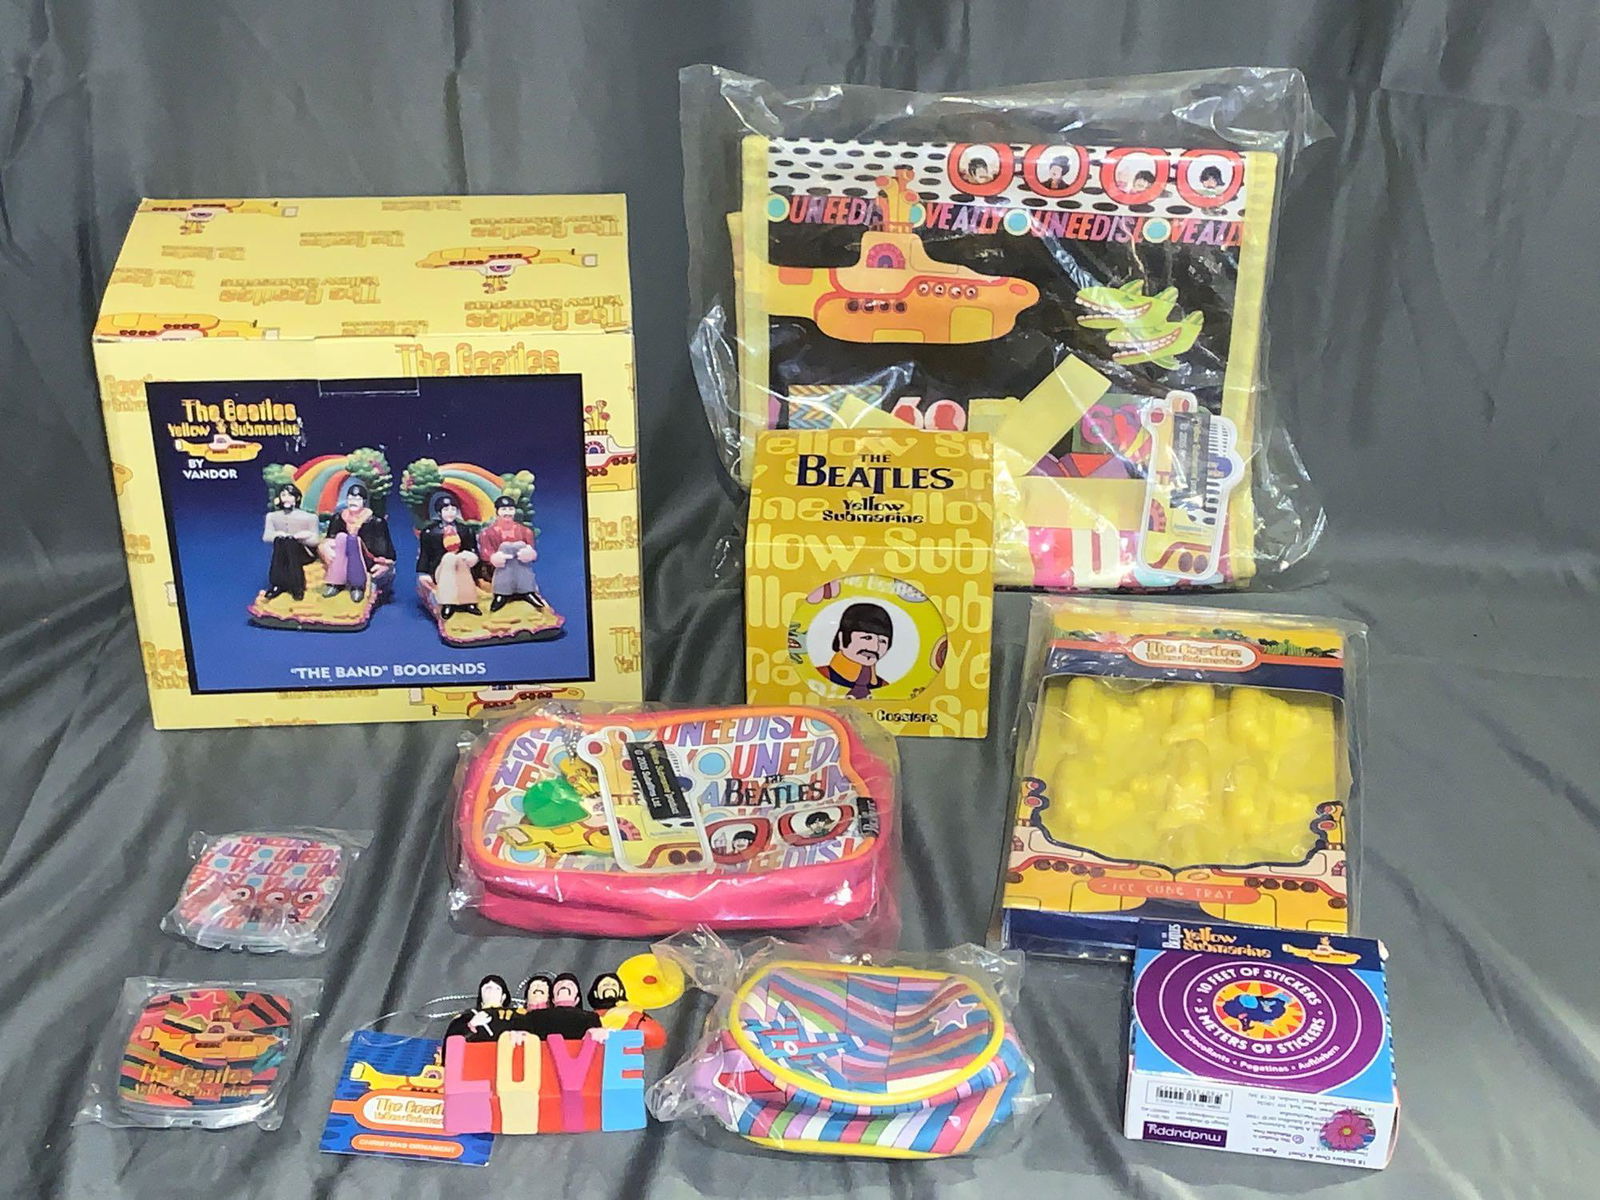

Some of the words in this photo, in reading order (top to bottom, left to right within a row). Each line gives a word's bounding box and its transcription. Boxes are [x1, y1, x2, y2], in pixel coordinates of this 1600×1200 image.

[465, 310, 569, 332] Beatles
[574, 307, 629, 329] The
[395, 343, 450, 376] The
[455, 341, 560, 376] Beatles
[181, 399, 220, 423] The
[222, 398, 298, 423] Beatles
[167, 422, 211, 438] Yellow
[229, 421, 301, 437] Submarine
[187, 458, 205, 469] BY
[860, 453, 892, 463] THE
[182, 468, 239, 480] VANDOR
[796, 454, 954, 495] BEATLES
[842, 495, 905, 511] Yellow
[822, 510, 924, 524] Submarine
[1144, 640, 1176, 655] The
[1179, 643, 1243, 658] Beatles
[290, 666, 330, 680] "THE
[336, 665, 388, 679] BAND"
[393, 662, 487, 677] BOOKENDS
[876, 709, 939, 724] Coasters
[724, 777, 824, 808] BEATLES
[1195, 887, 1235, 900] TRAY
[1183, 926, 1238, 944] Yellow
[1183, 940, 1272, 959] Submarine
[1197, 978, 1212, 995] 10
[1209, 968, 1237, 989] FEET
[1240, 966, 1260, 977] OF
[1263, 968, 1322, 1006] STICKERS
[1194, 1005, 1202, 1014] 3
[1198, 1014, 1248, 1051] METERS
[1252, 1042, 1274, 1055] OF
[1278, 1017, 1326, 1055] STICKERS
[1181, 1028, 1231, 1064] Autocollants
[444, 1030, 646, 1096] LOVE
[1146, 1123, 1222, 1142] mudpuppy
